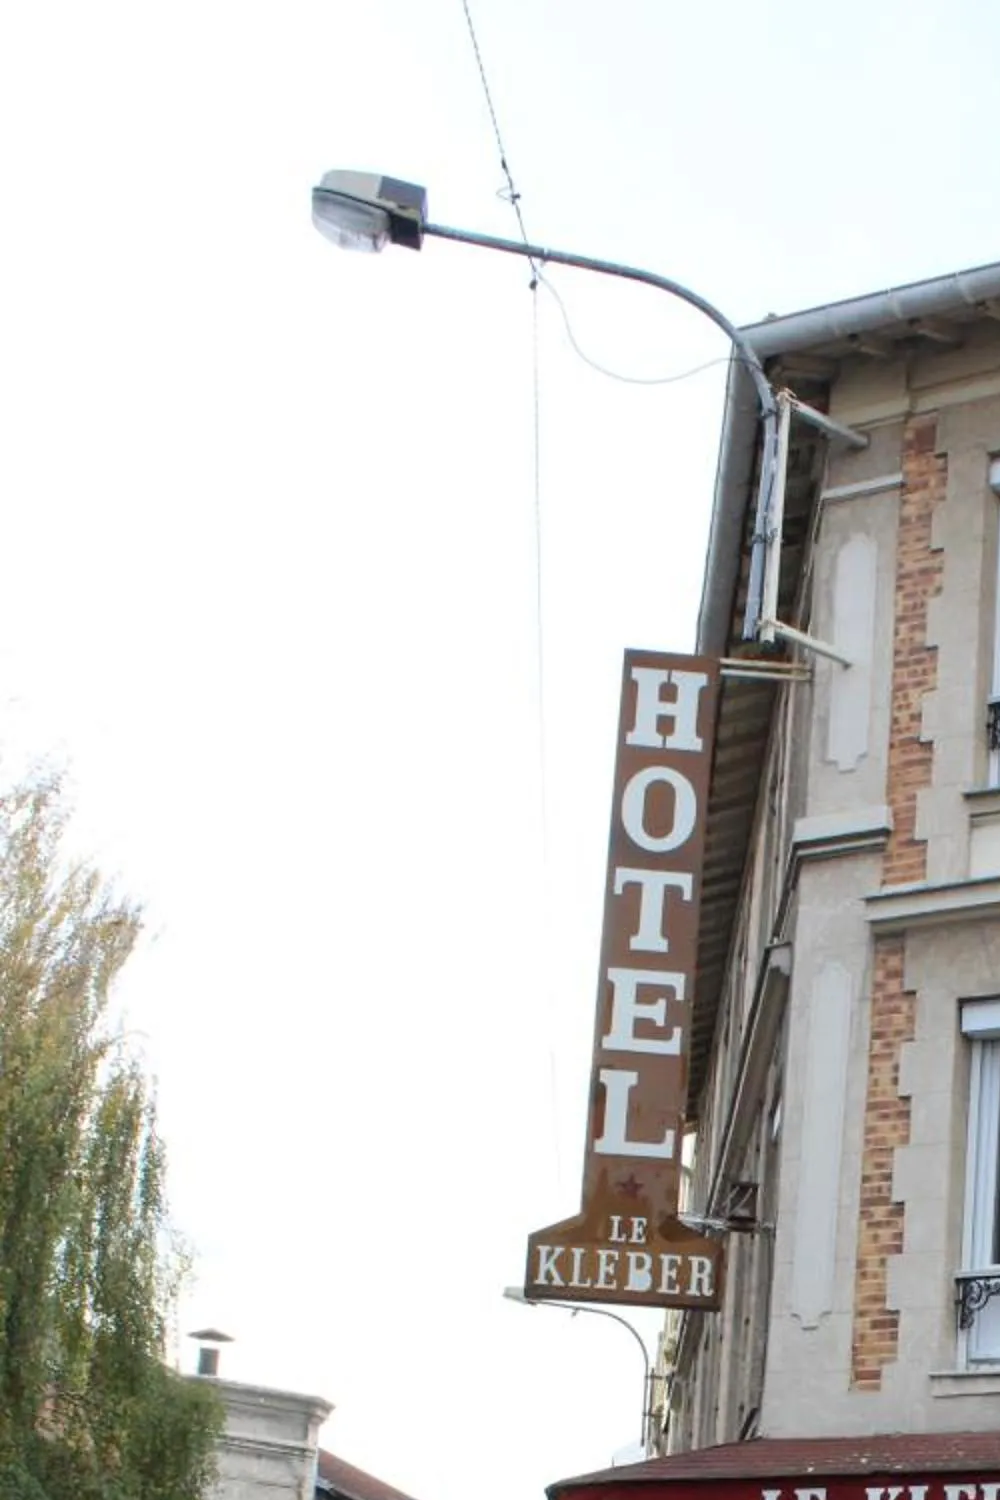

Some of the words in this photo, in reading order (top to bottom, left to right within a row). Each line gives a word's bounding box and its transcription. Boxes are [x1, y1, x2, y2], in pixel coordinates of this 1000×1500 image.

[593, 666, 708, 1160] HOTEL
[608, 1214, 648, 1245] LE
[534, 1244, 715, 1298] KLEBER
